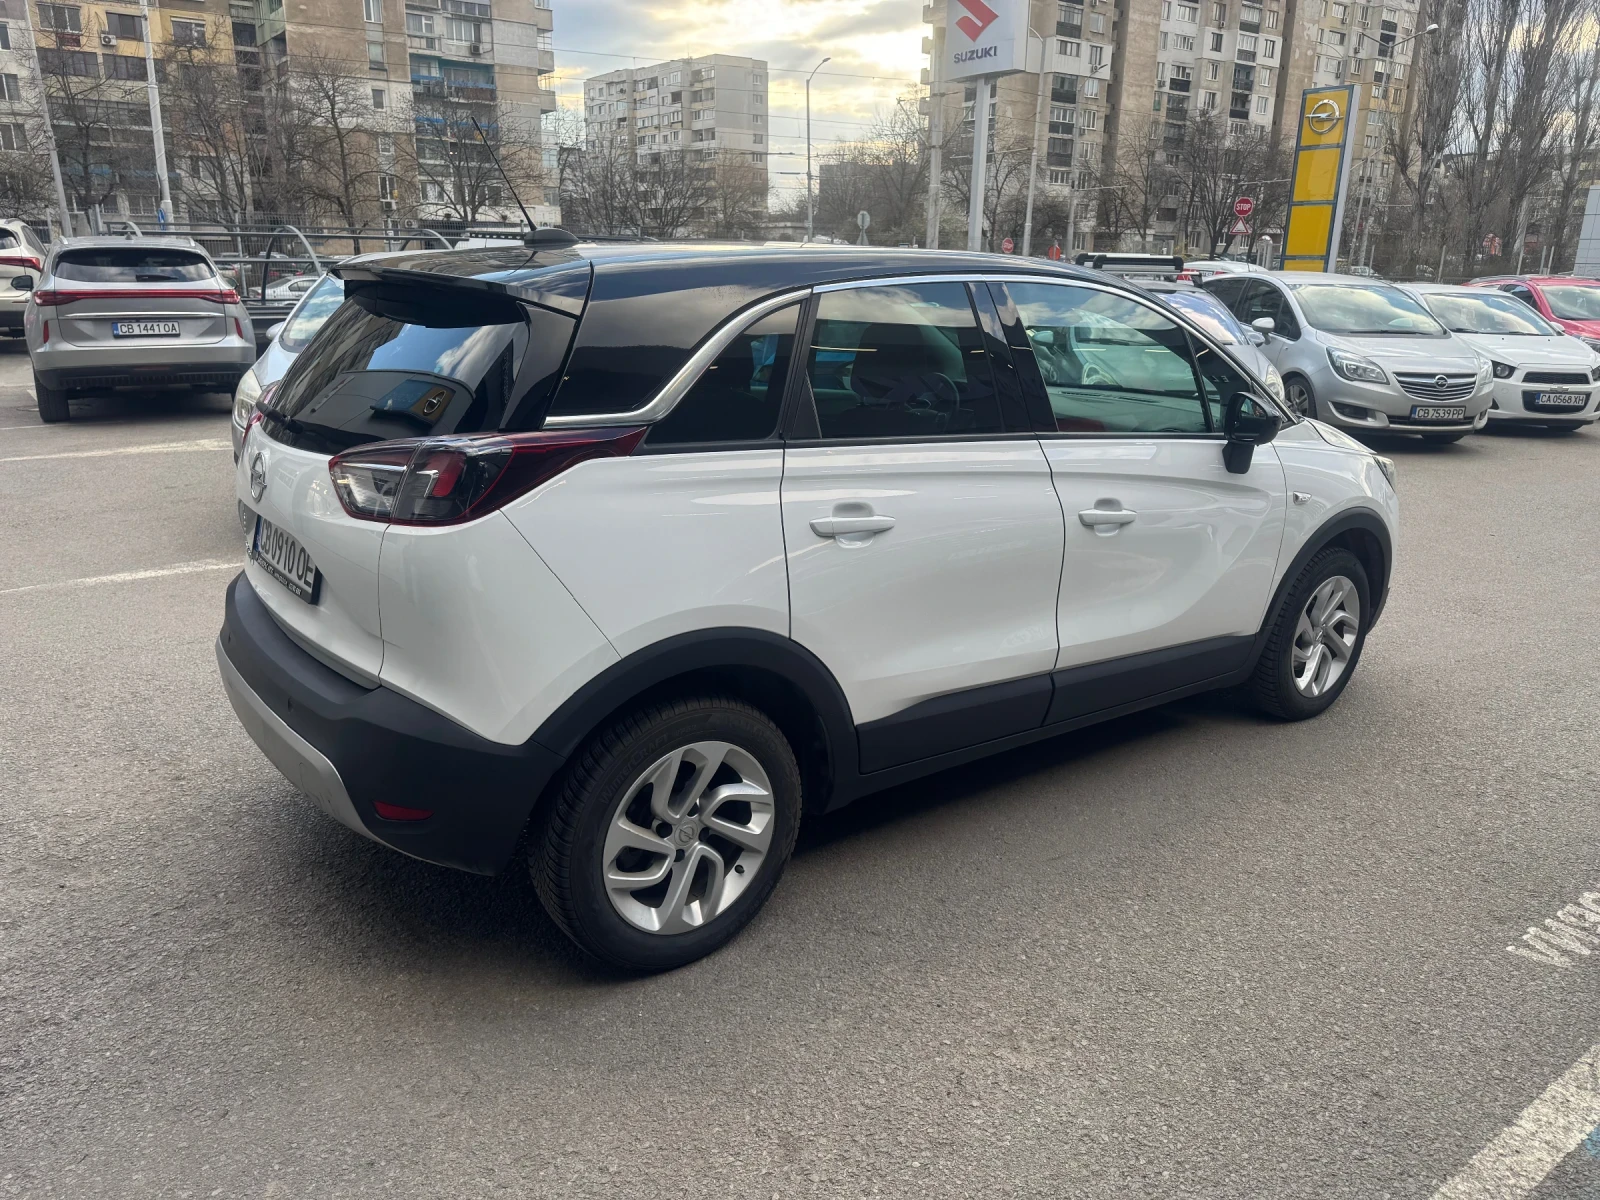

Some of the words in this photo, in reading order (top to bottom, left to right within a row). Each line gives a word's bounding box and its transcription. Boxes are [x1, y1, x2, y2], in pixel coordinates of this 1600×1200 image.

[953, 45, 998, 64] SUZUKI
[1236, 203, 1251, 211] STOP
[120, 324, 134, 334] CB
[137, 323, 161, 333] 1441
[163, 323, 177, 333] OA
[1540, 394, 1551, 404] CA
[1552, 394, 1572, 404] 0568
[1573, 395, 1585, 405] XH
[1417, 408, 1429, 418] CB
[1430, 408, 1451, 418] 7539
[1452, 408, 1465, 419] PP
[260, 518, 273, 556] CB
[271, 527, 296, 575] 0910
[296, 546, 314, 589] OE
